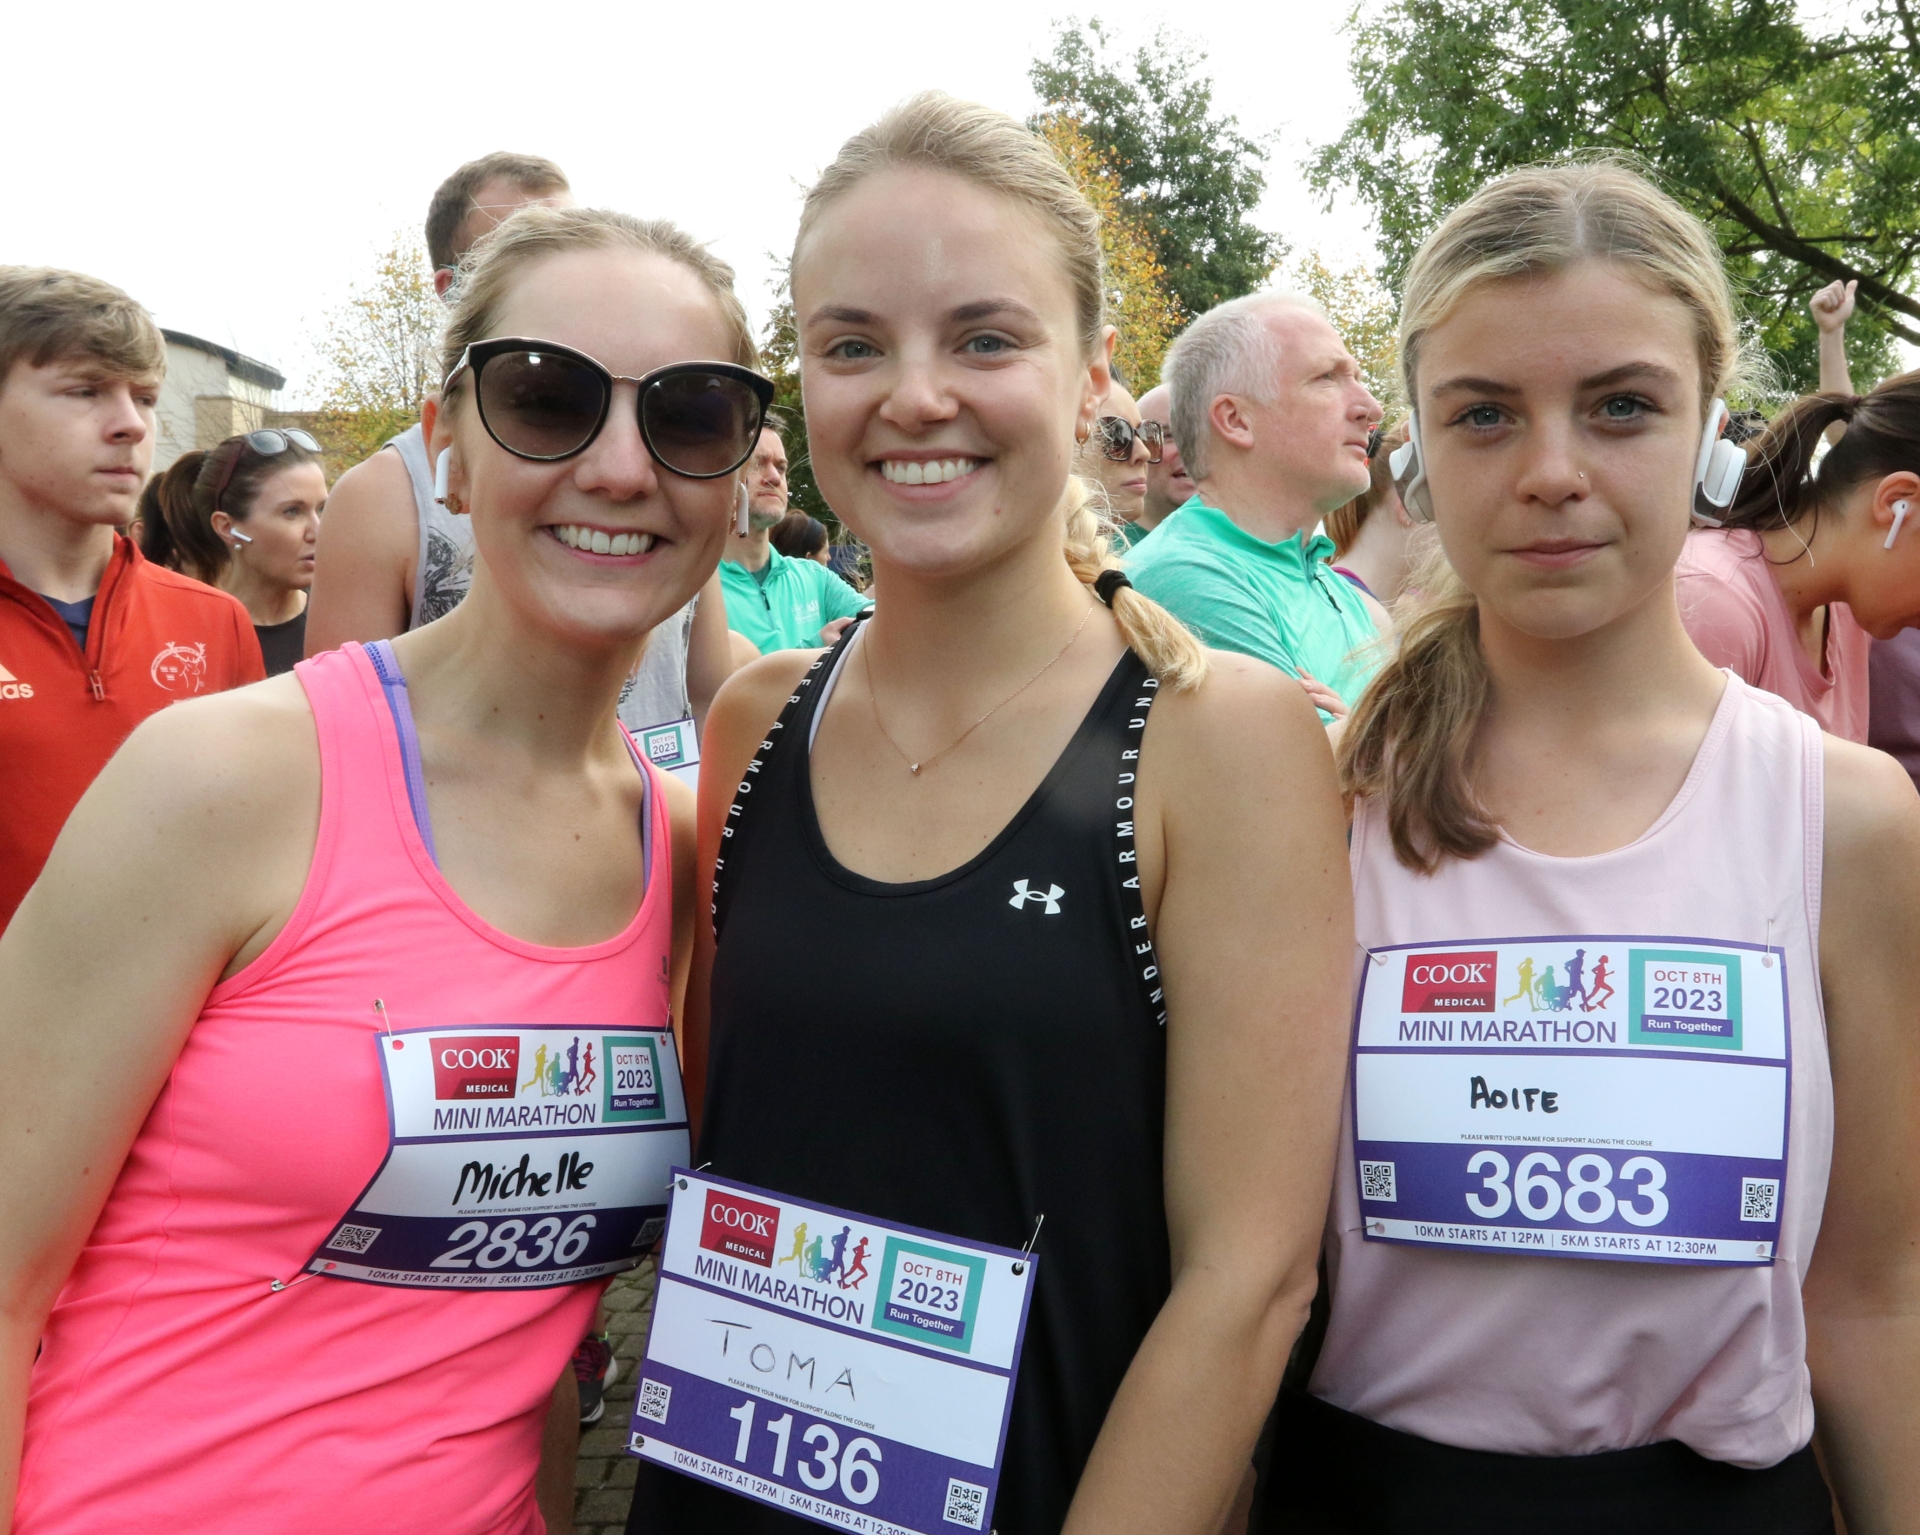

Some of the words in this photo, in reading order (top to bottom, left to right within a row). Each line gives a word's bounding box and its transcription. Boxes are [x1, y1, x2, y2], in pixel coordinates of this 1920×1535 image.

[653, 742, 676, 755] 2023
[722, 721, 783, 838] ARMOUR
[1117, 748, 1141, 889] ARMOUR
[1131, 914, 1166, 1026] UNDER
[1412, 963, 1487, 985] COOK
[1654, 970, 1688, 983] OCT
[1693, 972, 1722, 985] 8TH
[1434, 999, 1486, 1007] MEDICAL
[1653, 987, 1723, 1012] 2023
[1399, 1021, 1453, 1042] MINI
[1461, 1021, 1616, 1043] MARATHON
[1648, 1020, 1671, 1029] Run
[1674, 1020, 1723, 1033] Together
[441, 1049, 511, 1070] COOK
[616, 1055, 633, 1065] OCT
[635, 1055, 650, 1065] 8TH
[466, 1084, 509, 1093] MEDICAL
[617, 1069, 653, 1089] 2023
[614, 1100, 628, 1108] Run
[628, 1098, 655, 1108] Together
[1470, 1075, 1559, 1114] AOIFE
[434, 1107, 481, 1131] MINI
[485, 1104, 597, 1129] MARATHON
[1626, 1139, 1653, 1147] COURSE
[452, 1151, 594, 1206] Michelle
[1465, 1150, 1670, 1227] 3683
[711, 1204, 771, 1238] COOK
[429, 1214, 597, 1269] 2836
[725, 1241, 766, 1260] MEDICAL
[1414, 1225, 1445, 1238] 10KM
[1448, 1227, 1488, 1241] STARTS
[1491, 1231, 1509, 1243] AT
[1511, 1231, 1545, 1245] 12PM
[1561, 1235, 1590, 1248] 5KM
[1594, 1237, 1641, 1250] STARTS
[1645, 1239, 1663, 1252] AT
[1666, 1241, 1718, 1255] 12:30PM
[367, 1269, 400, 1280] 10KM
[401, 1273, 440, 1283] STARTS
[442, 1276, 457, 1284] AT
[459, 1275, 488, 1284] 12PM
[498, 1275, 521, 1284] 5KM
[523, 1273, 556, 1283] STARTS
[557, 1272, 569, 1280] AT
[903, 1262, 933, 1278] OCT
[936, 1270, 963, 1286] 8TH
[695, 1255, 738, 1287] MINI
[742, 1270, 865, 1325] MARATHON
[898, 1279, 959, 1312] 2023
[890, 1308, 910, 1321] Run
[912, 1314, 955, 1333] Together
[705, 1319, 855, 1402] TOMA
[728, 1377, 746, 1388] PLEASE
[746, 1384, 762, 1393] WRITE
[762, 1388, 775, 1398] YOUR
[775, 1393, 789, 1402] NAME
[789, 1398, 800, 1406] FOR
[800, 1402, 824, 1414] SUPPORT
[824, 1410, 843, 1421] ALONG
[843, 1415, 854, 1424] THE
[854, 1419, 876, 1430] COURSE
[730, 1400, 883, 1505] 1136
[673, 1450, 699, 1470] 10KM
[701, 1461, 734, 1483] STARTS
[735, 1474, 749, 1488] AT
[751, 1481, 778, 1499] 12PM
[789, 1494, 812, 1511] 5KM
[815, 1503, 851, 1524] STARTS
[854, 1517, 868, 1530] AT
